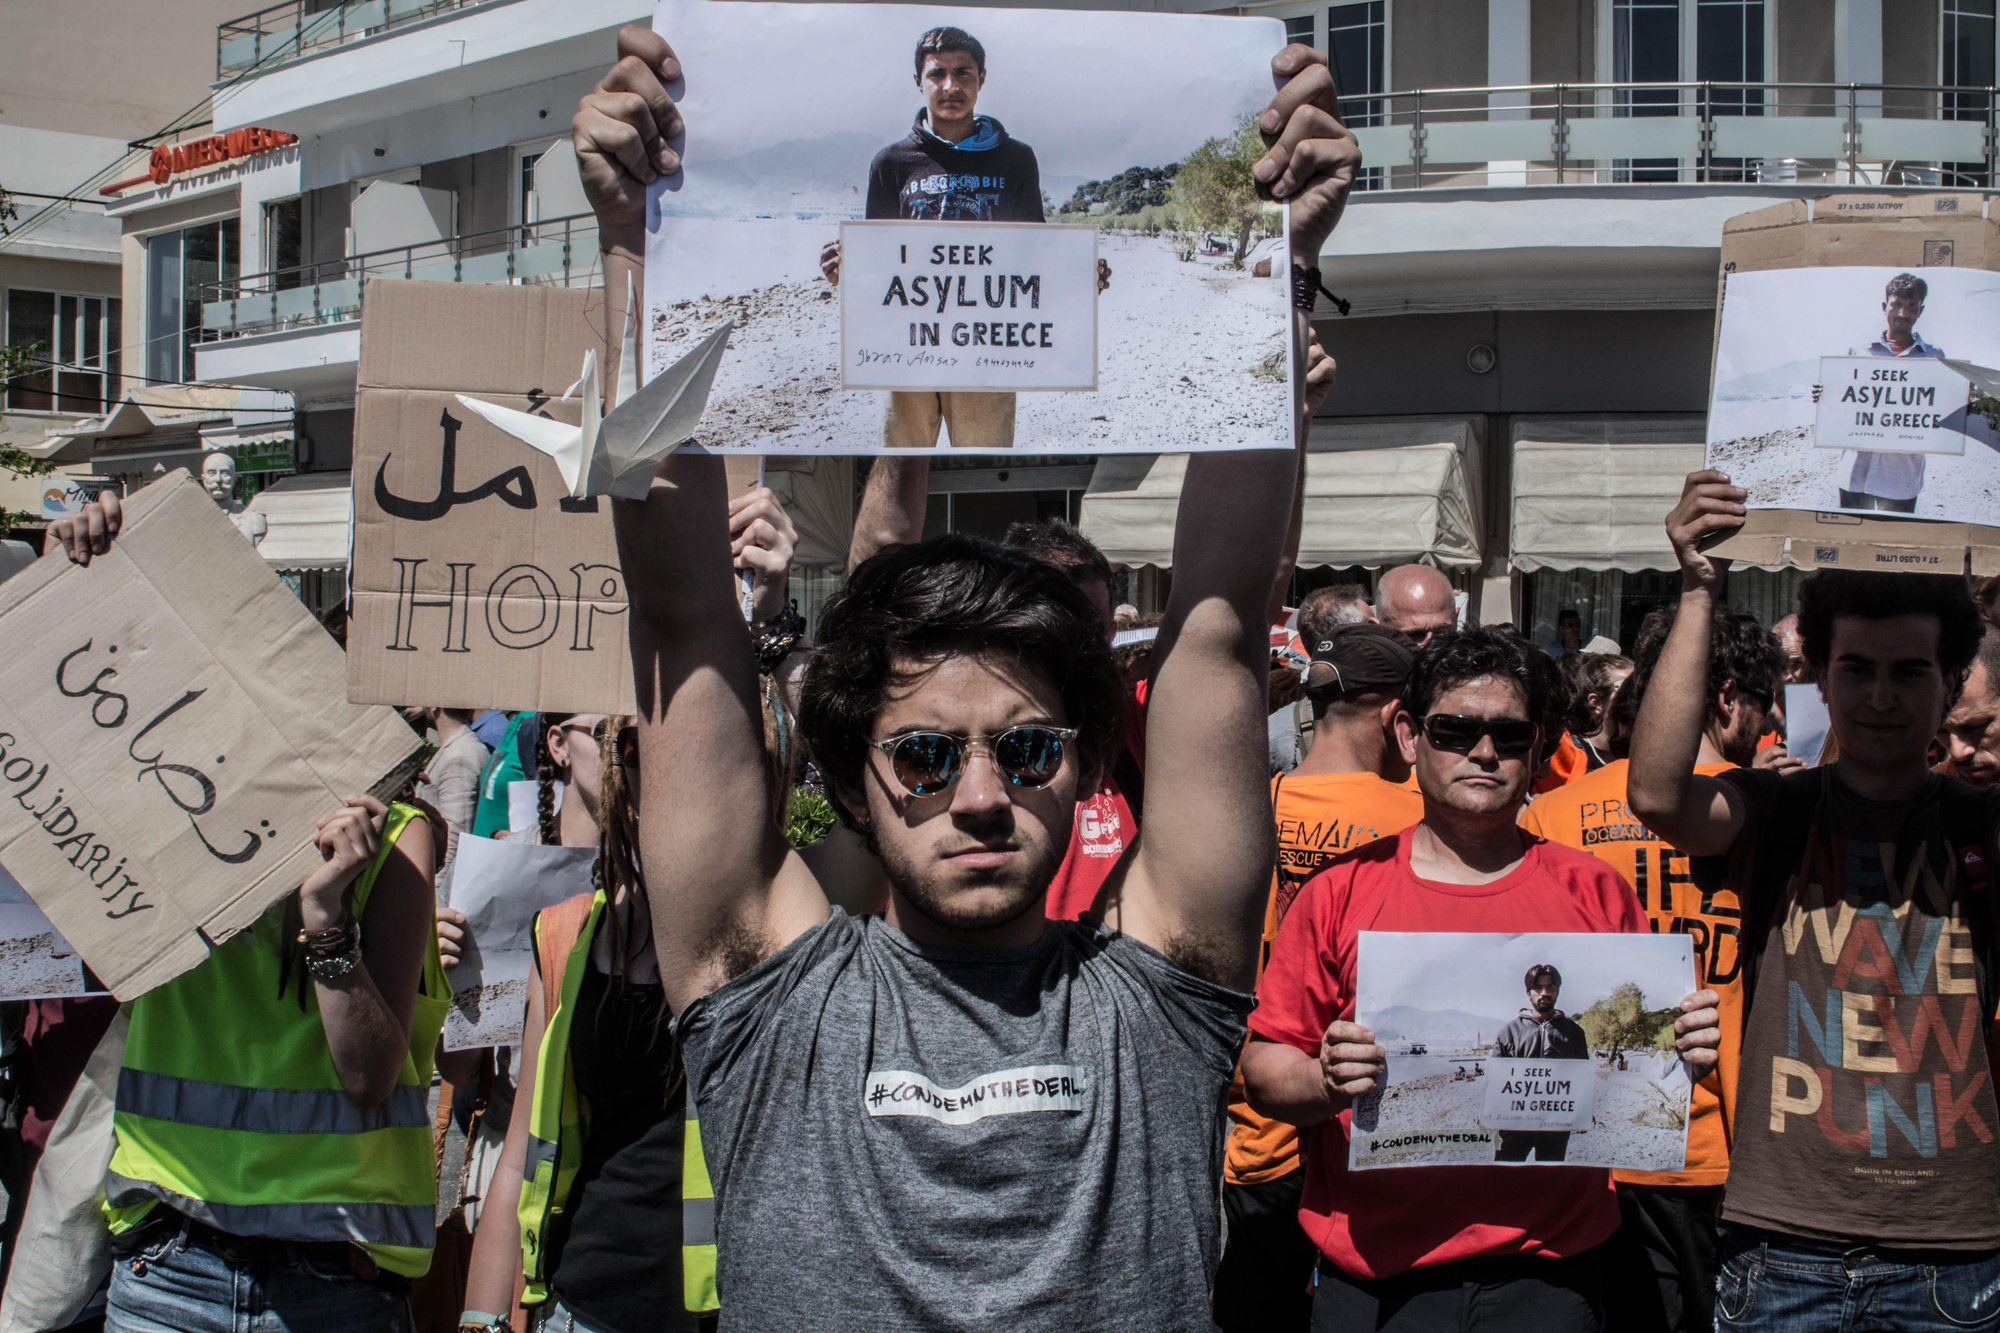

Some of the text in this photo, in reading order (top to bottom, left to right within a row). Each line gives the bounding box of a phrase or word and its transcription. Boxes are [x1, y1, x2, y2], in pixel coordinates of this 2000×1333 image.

[1855, 203, 1875, 211] 0,250
[900, 244, 994, 265] I SEEK
[882, 275, 1041, 314] ASYLUM
[909, 322, 1053, 348] IN GREECE
[1854, 368, 1909, 382] I SEEK
[1841, 385, 1936, 408] ASYLUM
[1855, 412, 1941, 429] IN GREECE
[1876, 554, 1898, 562] LITRE
[1899, 555, 1920, 564] 0,250
[1929, 556, 1939, 564] 27
[1586, 827, 1642, 843] OCEAN
[1782, 874, 1977, 995] WAVE
[1788, 980, 1979, 1073] NEW
[1511, 1067, 1552, 1077] I SEEK
[869, 1077, 1080, 1111] #CONDEMNTHEDEAL
[1501, 1080, 1571, 1097] ASYLUM
[1511, 1100, 1575, 1112] IN GREECE
[1769, 1055, 1994, 1158] PUNK
[1854, 1166, 1879, 1174] BORN
